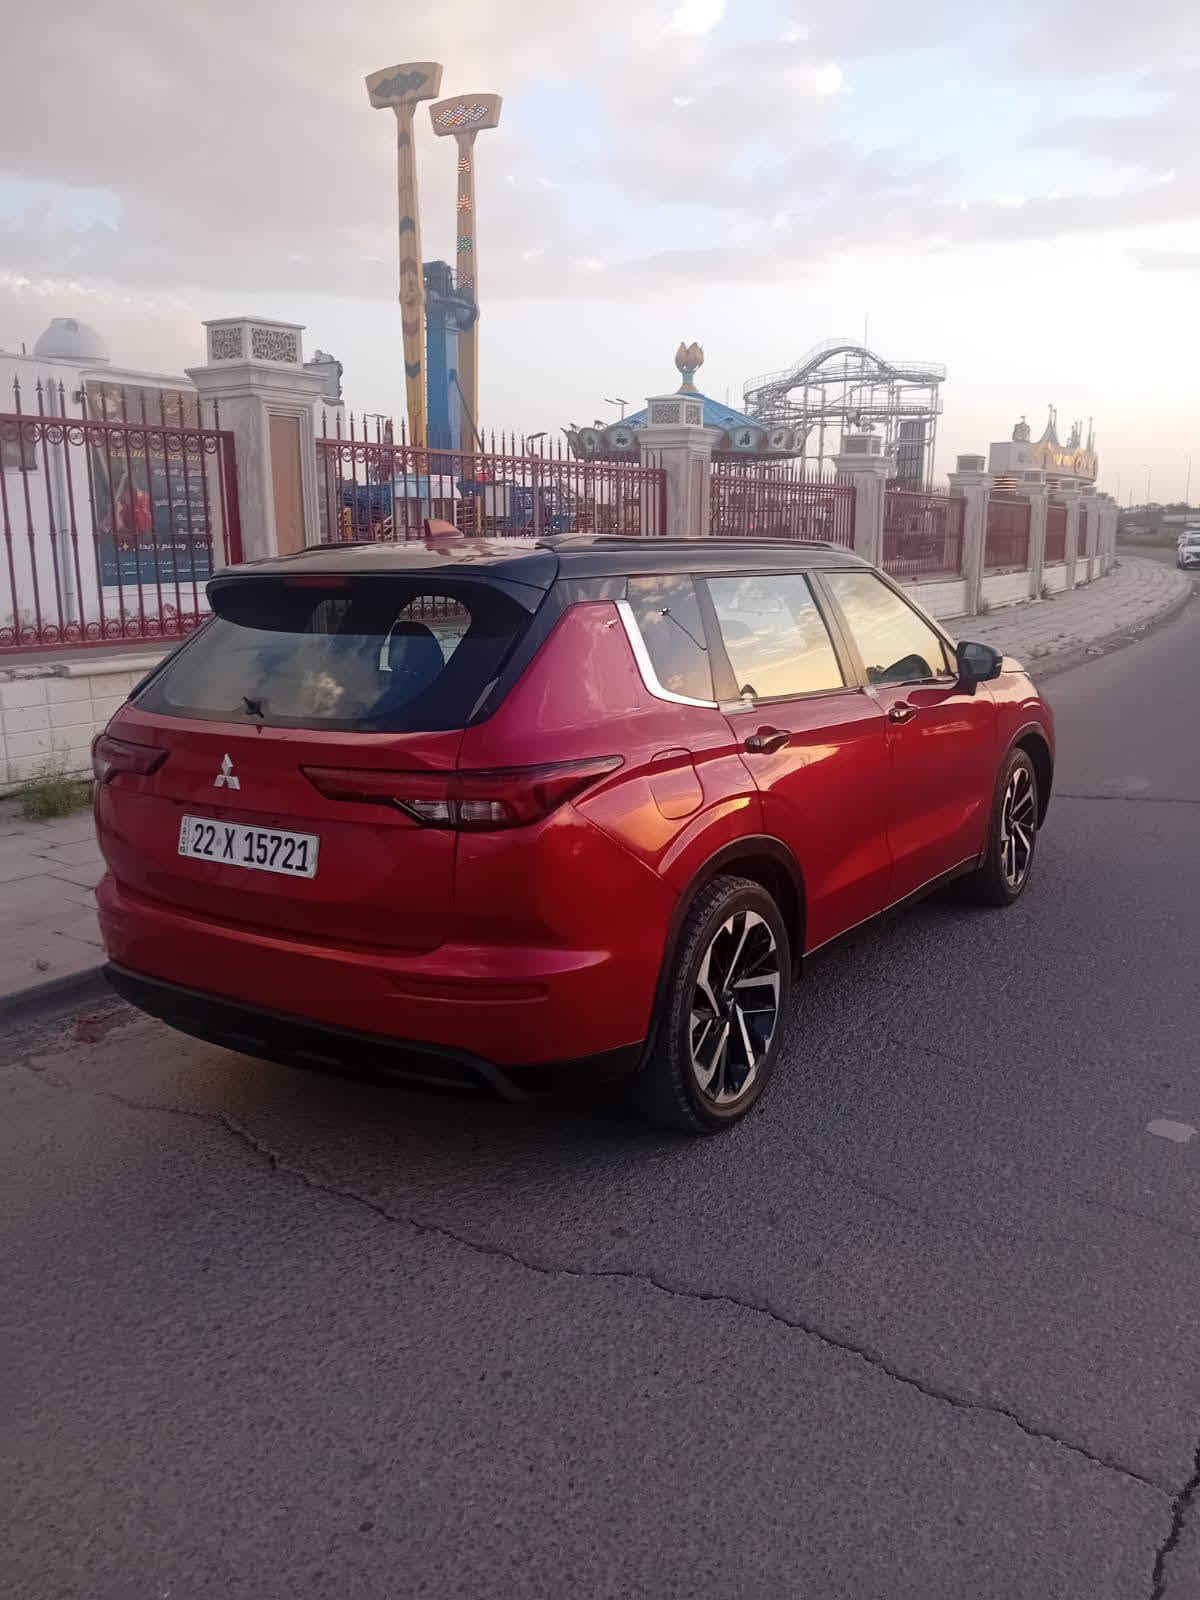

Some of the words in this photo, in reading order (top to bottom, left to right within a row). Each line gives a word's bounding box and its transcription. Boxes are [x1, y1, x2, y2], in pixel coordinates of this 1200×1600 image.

[193, 823, 216, 856] 22
[223, 827, 236, 859] X
[243, 831, 309, 872] 15721
